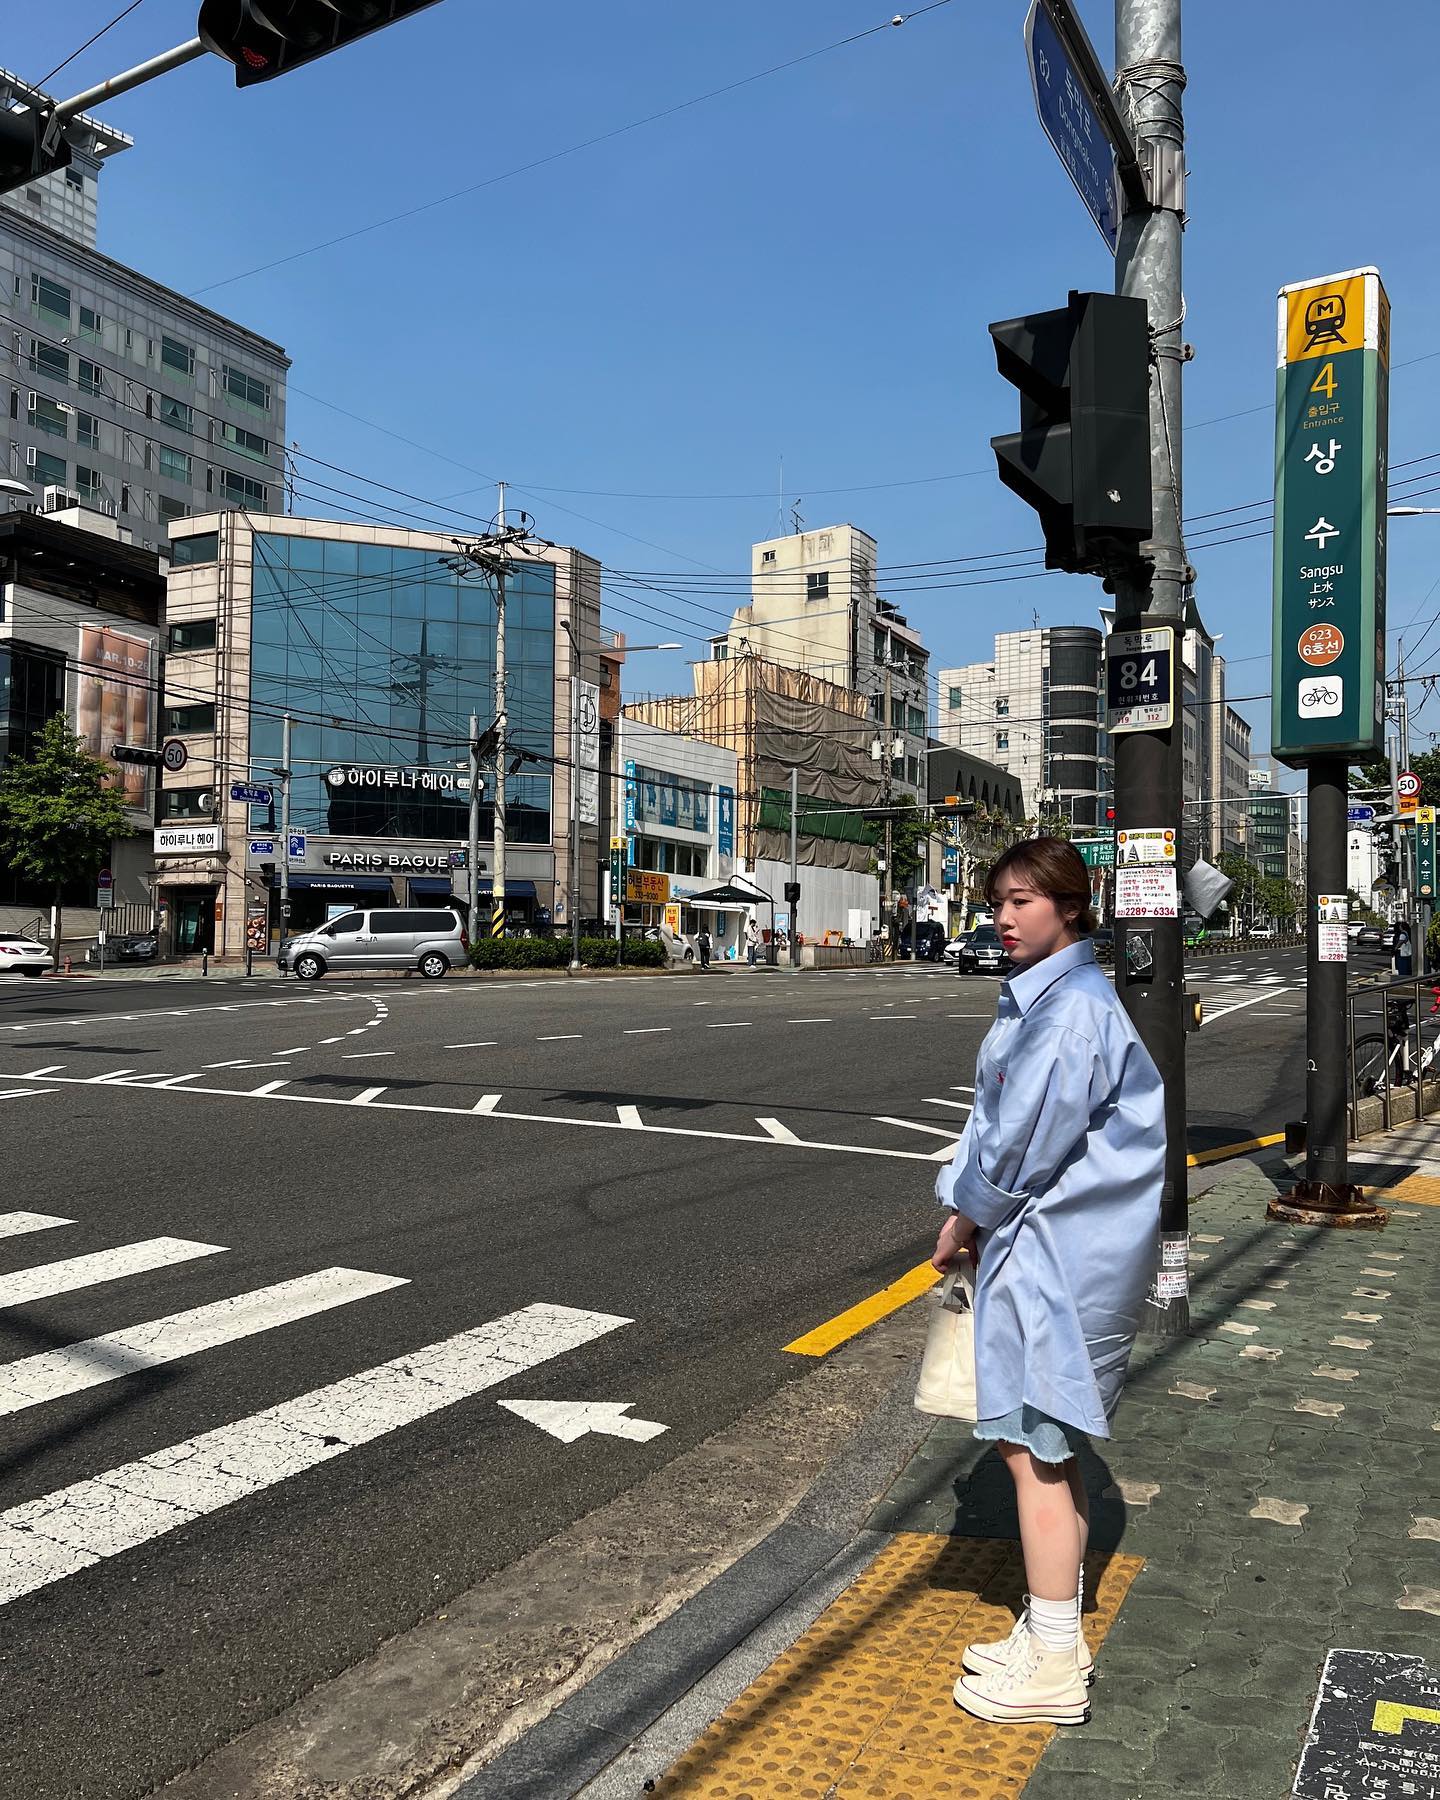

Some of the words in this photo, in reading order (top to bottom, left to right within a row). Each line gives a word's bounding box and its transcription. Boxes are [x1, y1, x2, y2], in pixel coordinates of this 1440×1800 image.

[1064, 67, 1092, 143] 독막로
[1310, 362, 1338, 399] 4
[1308, 402, 1341, 418] 출입구
[1303, 415, 1345, 430] Entrance
[1300, 562, 1344, 580] Sangsu
[1309, 581, 1334, 595] 上水
[1308, 597, 1335, 609] サンス
[1124, 633, 1153, 646] 독막로
[1309, 628, 1332, 642] 623
[1303, 641, 1340, 657] 6호선
[1120, 658, 1158, 690] 84
[1117, 716, 1130, 724] 119
[167, 748, 182, 763] 50
[347, 768, 418, 789] 하이루나
[421, 772, 454, 791] 헤어
[1400, 779, 1415, 791] 50
[160, 833, 195, 847] 하이루나
[197, 833, 214, 845] 헤어
[330, 853, 383, 866] PARIS
[388, 854, 449, 868] BAGUE
